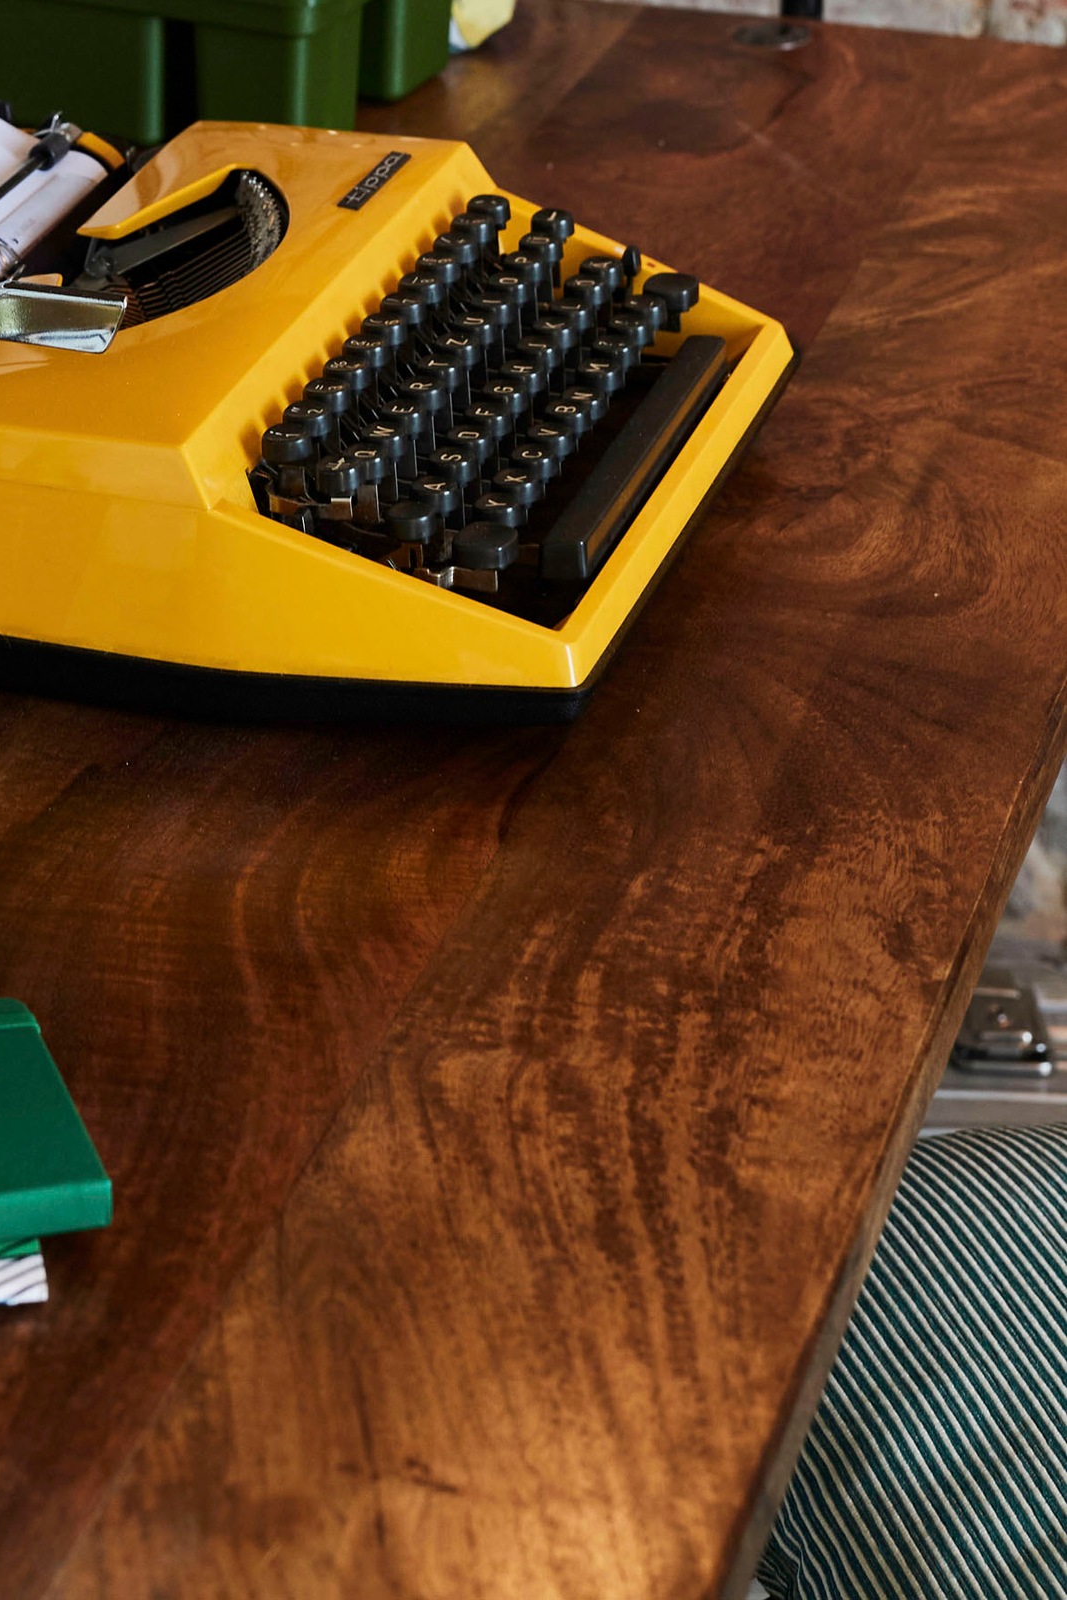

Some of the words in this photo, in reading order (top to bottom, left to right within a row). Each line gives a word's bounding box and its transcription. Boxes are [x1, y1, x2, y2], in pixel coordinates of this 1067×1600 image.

[345, 153, 406, 205] tippa
[428, 359, 449, 367] T
[510, 364, 533, 373] H
[409, 381, 433, 390] R
[493, 385, 514, 394] G
[571, 391, 593, 400] N
[391, 405, 414, 413] E
[475, 407, 495, 416] F
[554, 404, 577, 413] B
[369, 425, 395, 437] W
[457, 431, 480, 439] D
[537, 428, 559, 436] V
[354, 450, 377, 458] Q
[440, 453, 463, 462] S
[521, 450, 543, 458] C
[504, 474, 527, 483] X
[423, 482, 446, 491] A
[485, 499, 507, 507] Y
